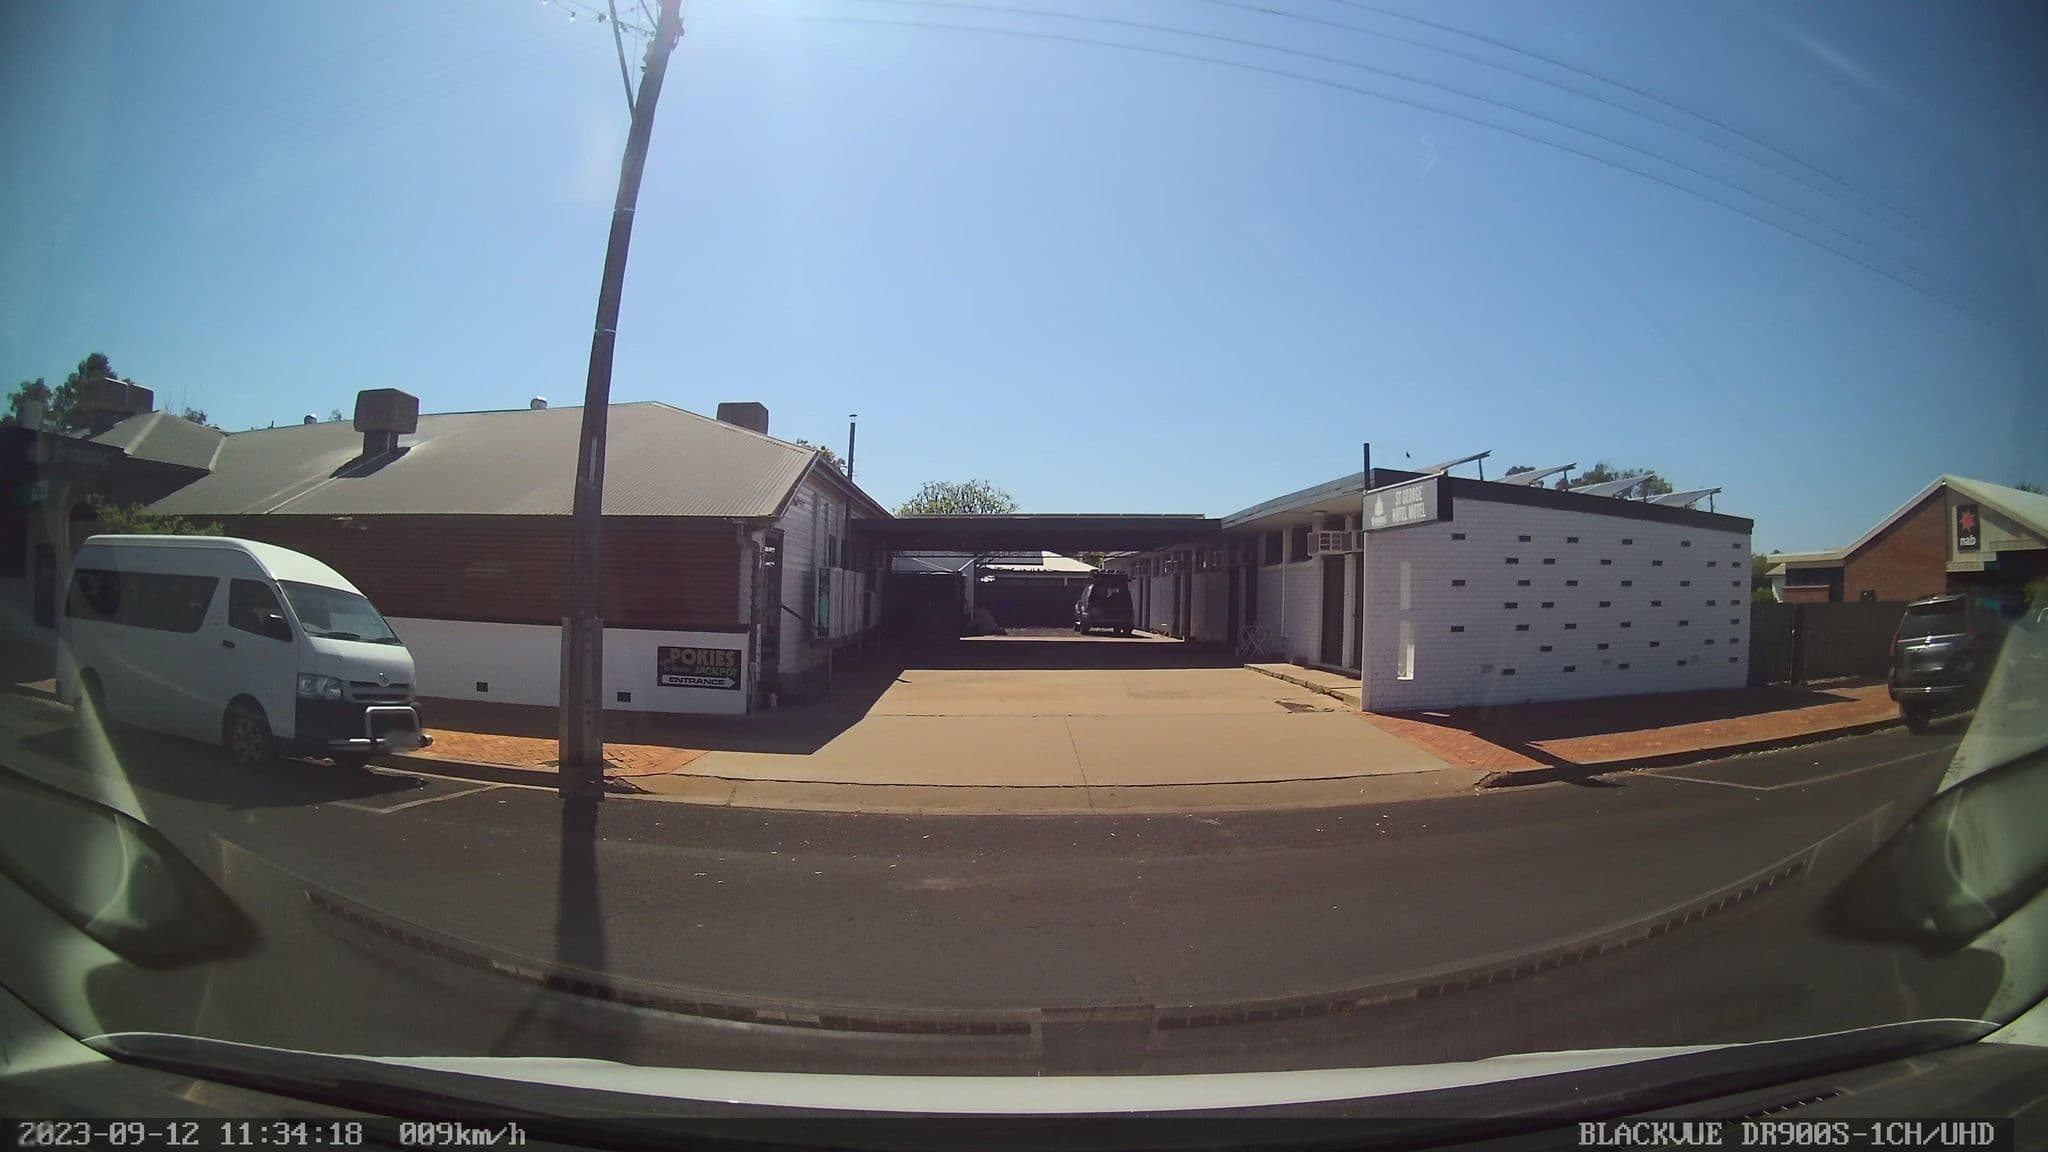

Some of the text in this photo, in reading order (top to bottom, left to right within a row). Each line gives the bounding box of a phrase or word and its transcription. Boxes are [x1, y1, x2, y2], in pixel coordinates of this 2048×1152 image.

[1960, 534, 1976, 546] nab
[670, 647, 735, 667] POKIES
[694, 665, 737, 677] JACKPOT
[668, 676, 726, 686] ENTRANCE
